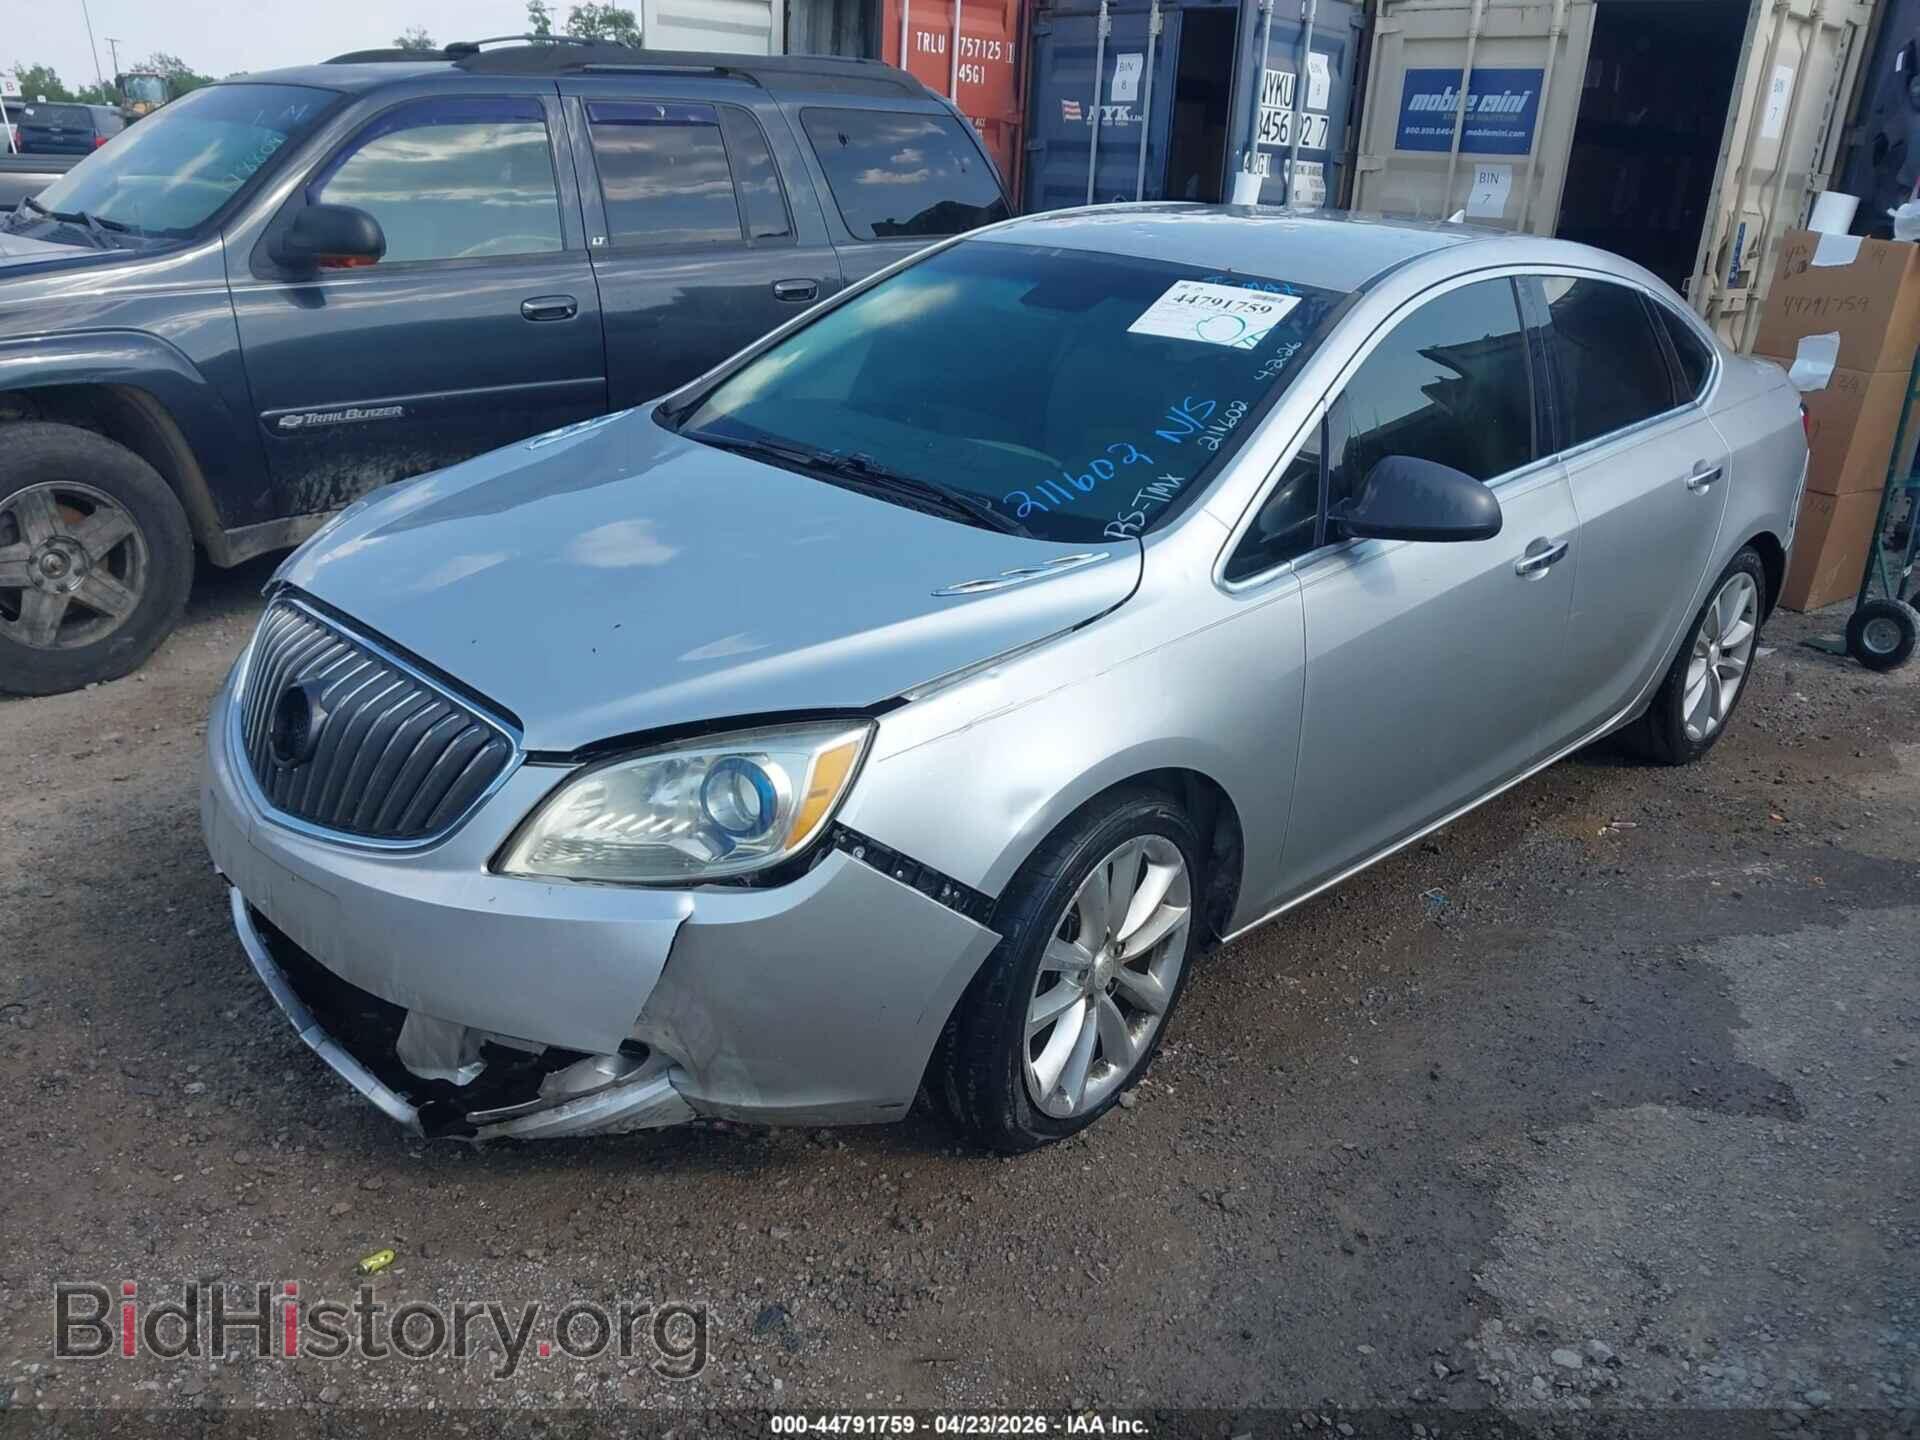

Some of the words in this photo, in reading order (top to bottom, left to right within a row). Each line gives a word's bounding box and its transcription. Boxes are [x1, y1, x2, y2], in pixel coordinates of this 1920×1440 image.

[917, 32, 945, 53] TRLU
[960, 37, 1001, 60] 757125
[959, 64, 985, 84] 45G1
[1479, 172, 1500, 185] BIN
[1174, 292, 1272, 315] 44791759
[1198, 400, 1248, 451] 211602
